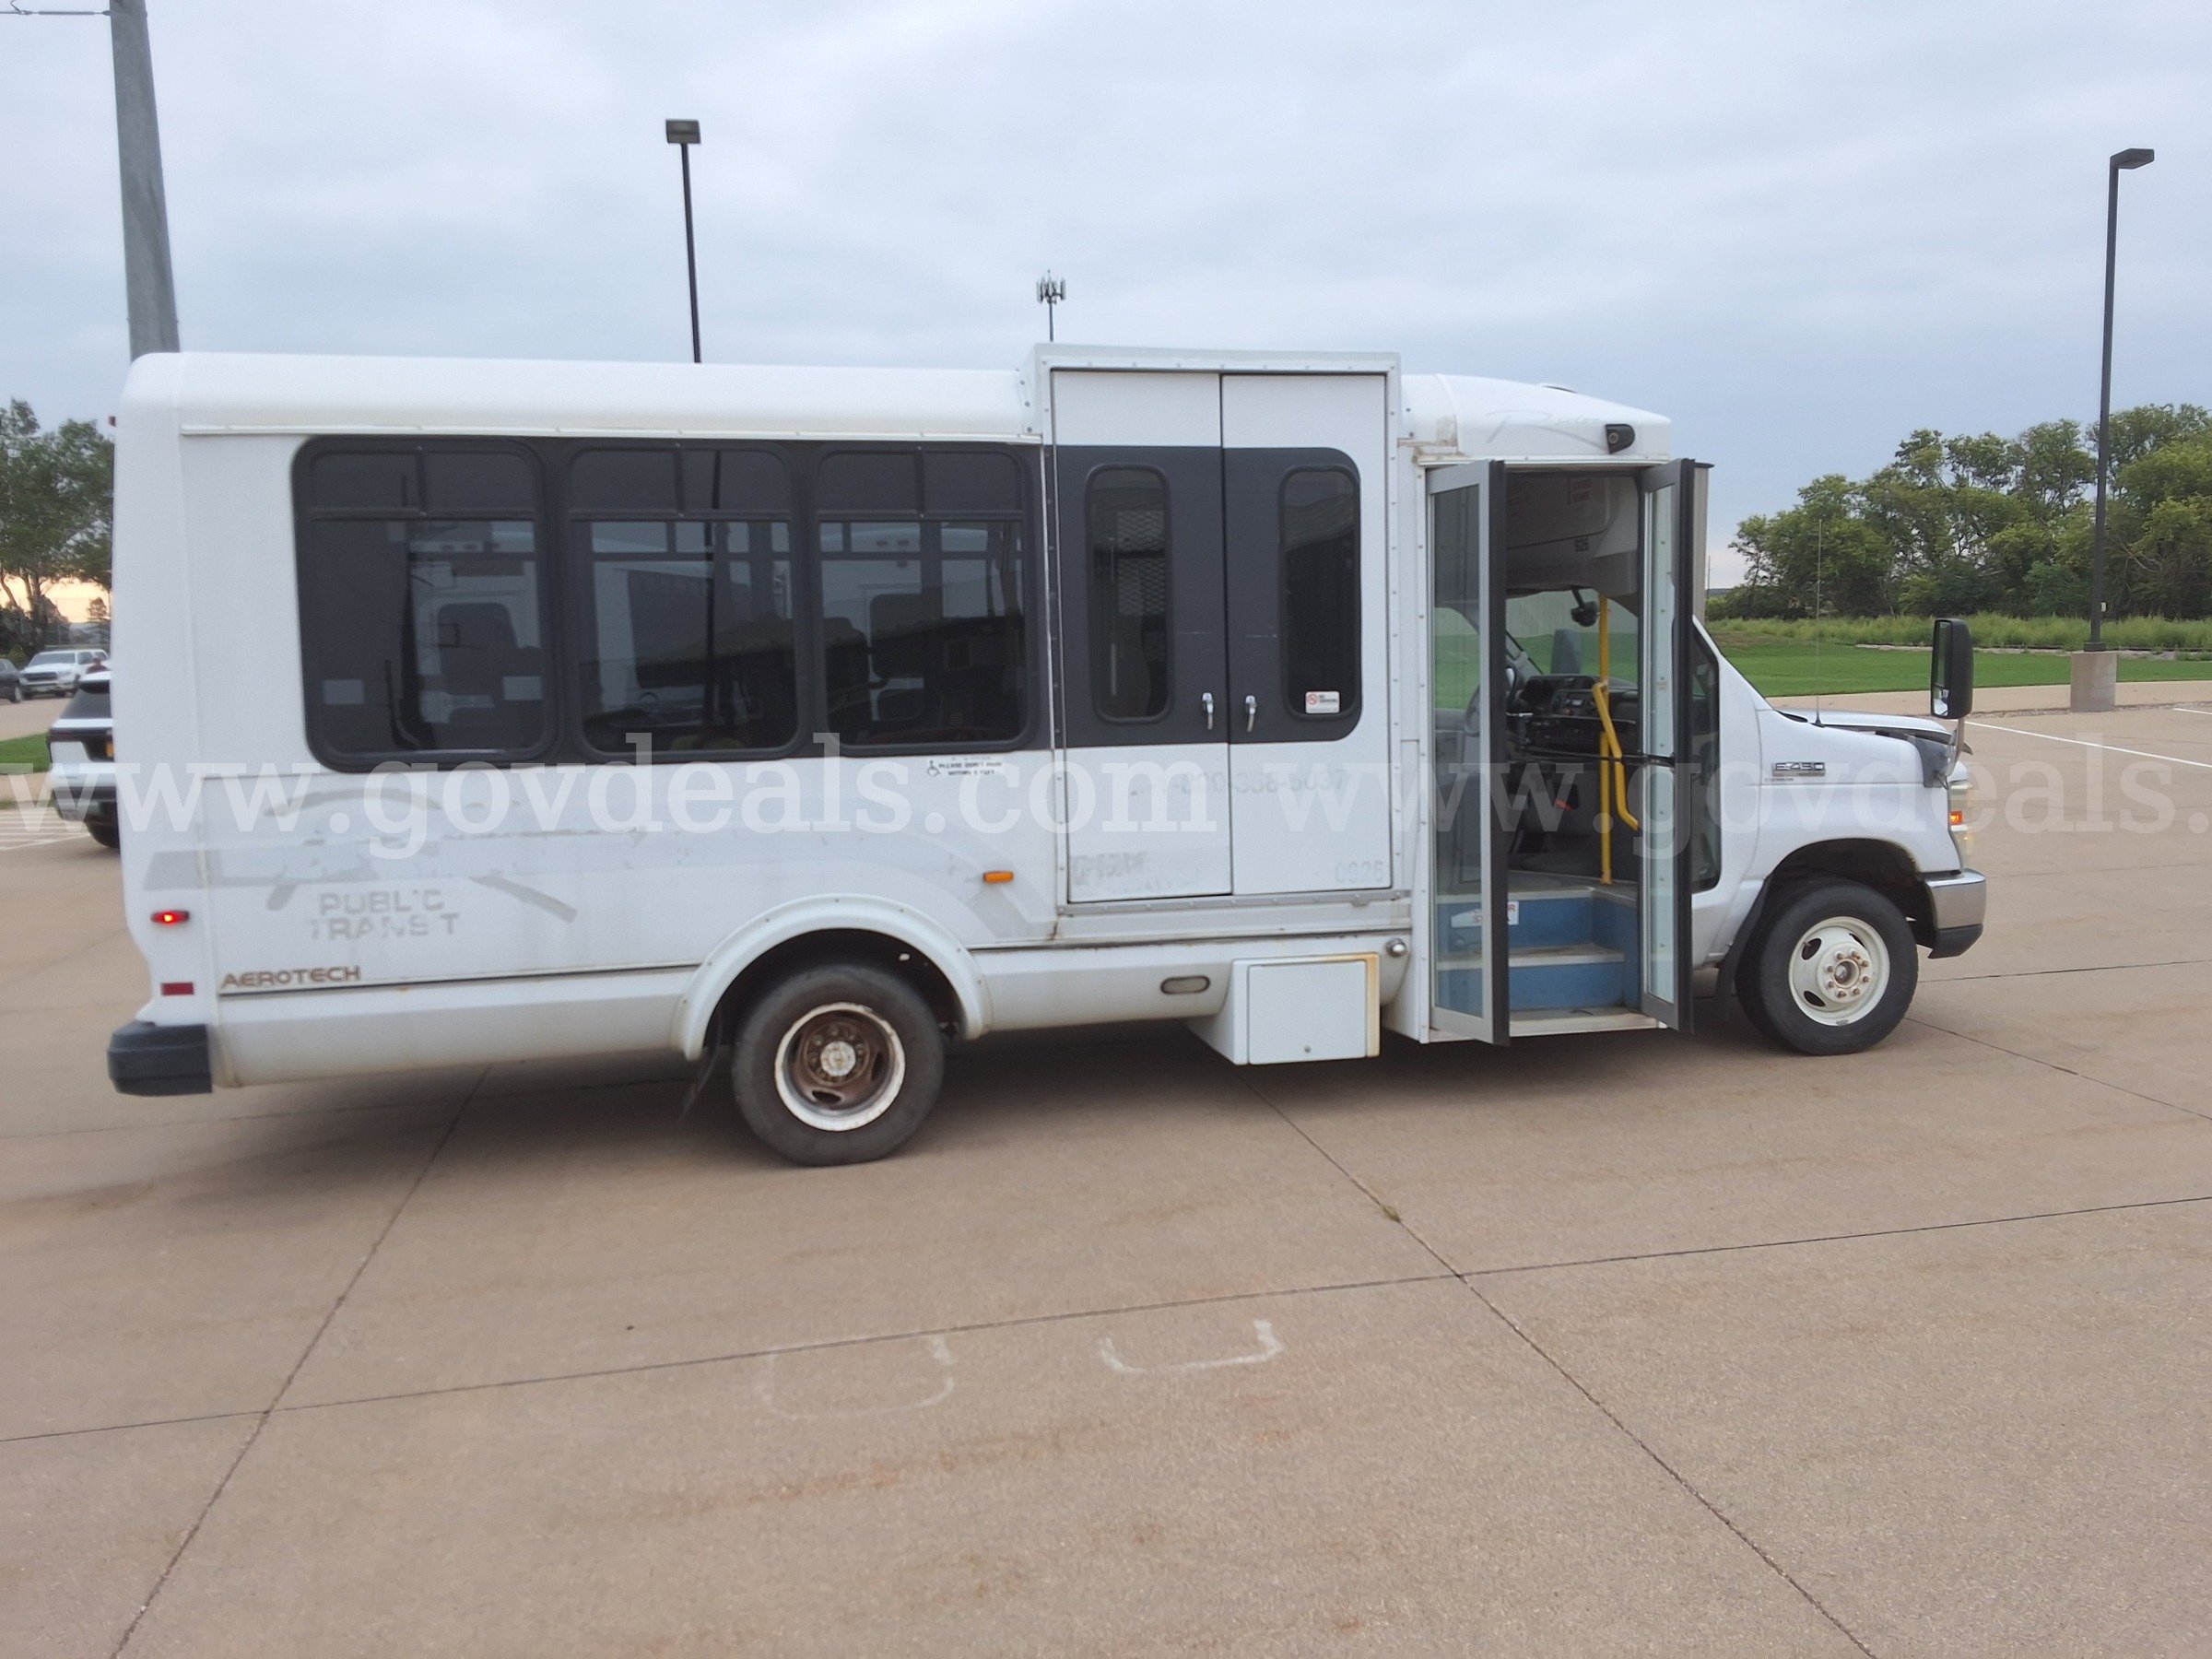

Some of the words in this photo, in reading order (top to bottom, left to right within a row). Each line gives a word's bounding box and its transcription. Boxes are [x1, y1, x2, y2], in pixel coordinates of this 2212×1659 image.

[1775, 761, 1826, 771] E-450
[320, 888, 444, 915] PUBLC
[221, 965, 362, 989] AEROTECH
